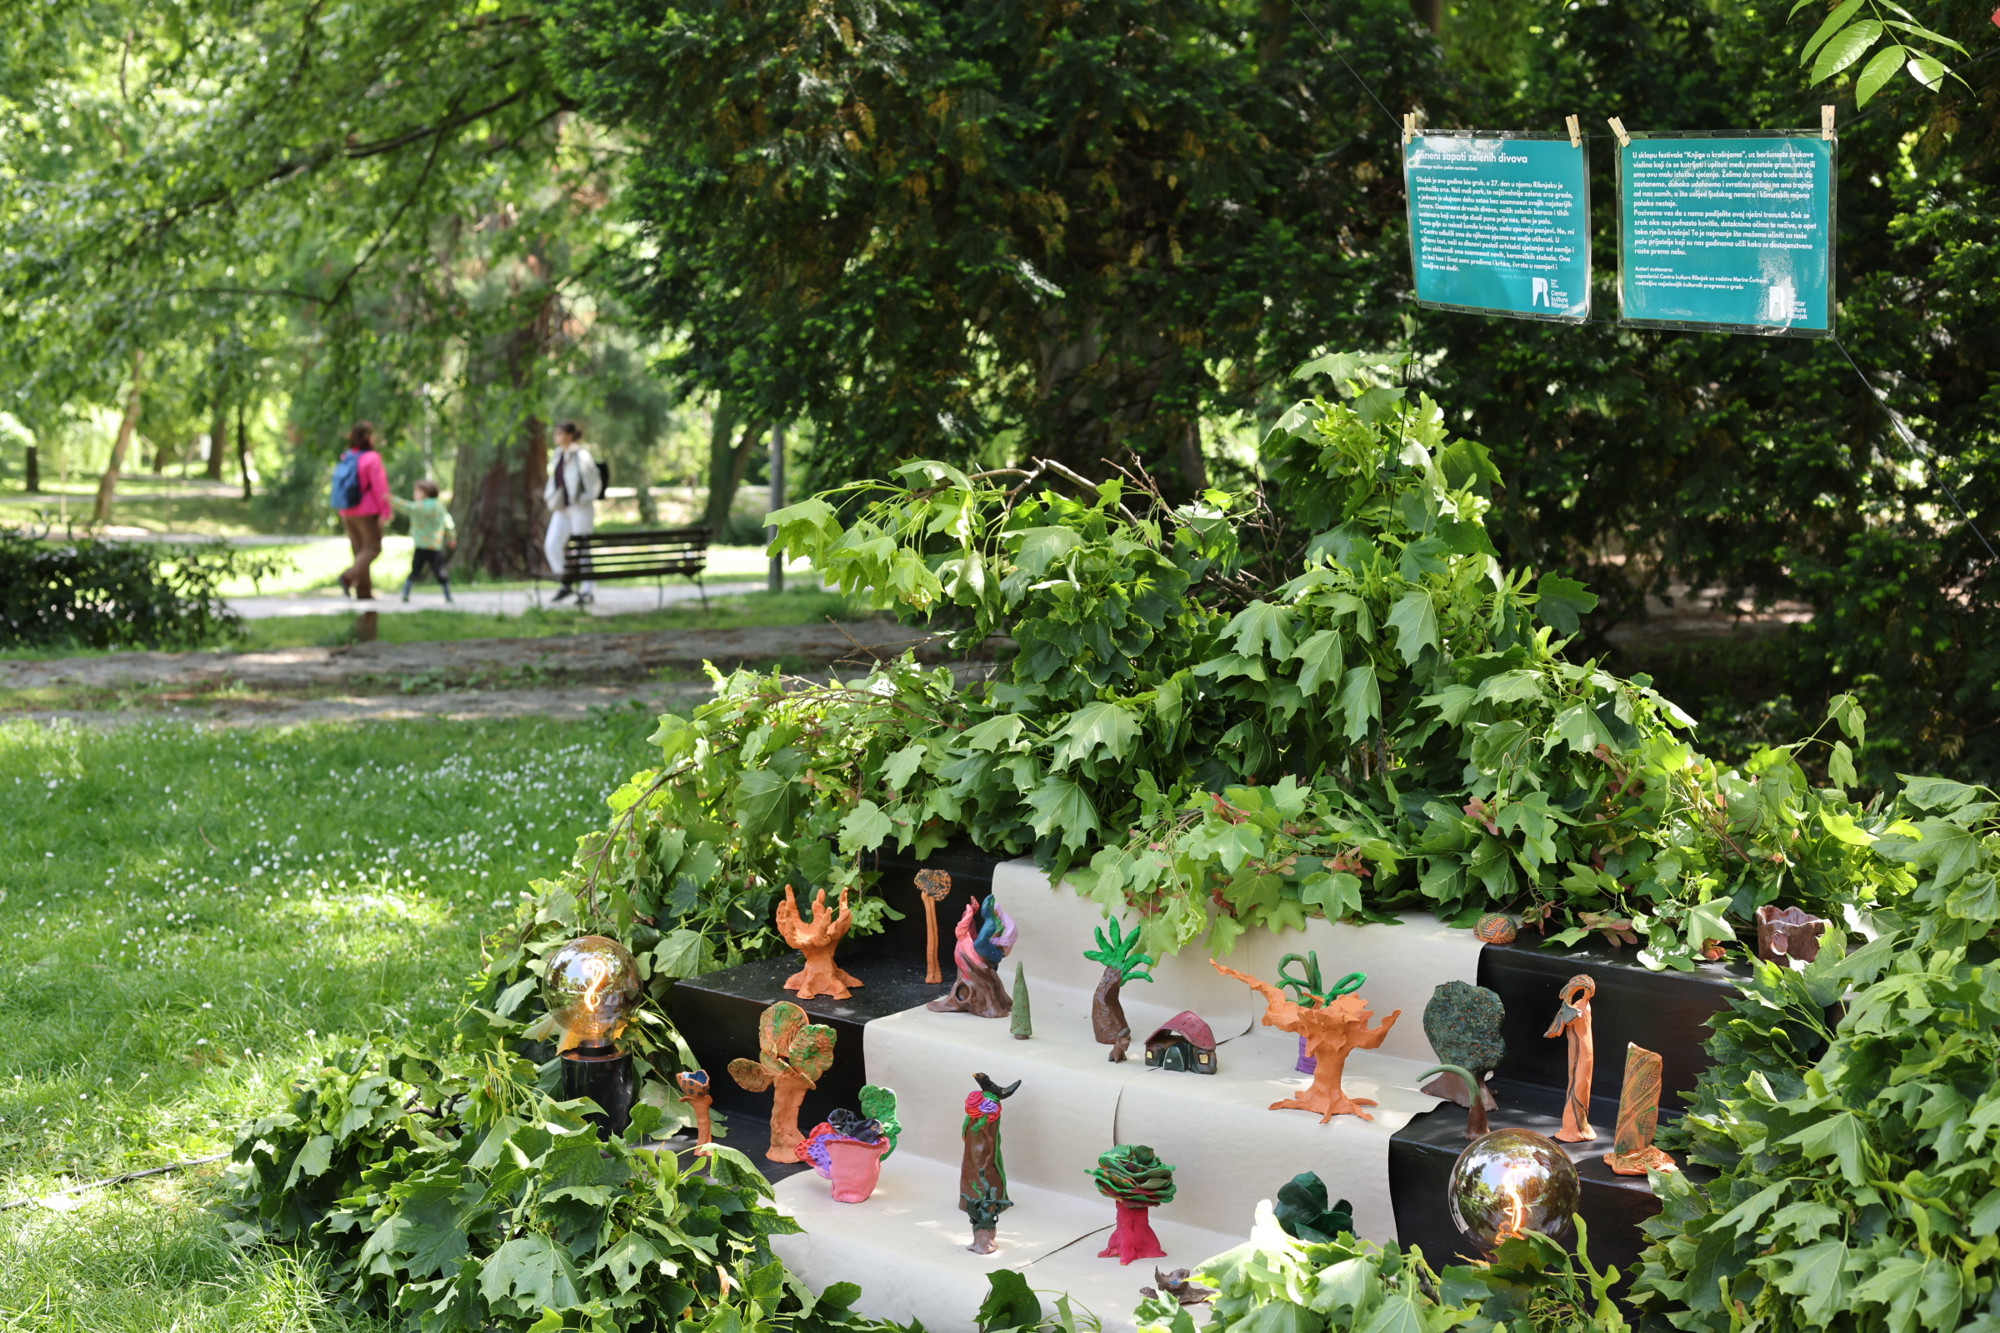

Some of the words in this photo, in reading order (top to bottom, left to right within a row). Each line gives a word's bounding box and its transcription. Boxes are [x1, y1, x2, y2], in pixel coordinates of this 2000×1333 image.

[1416, 150, 1440, 161] Glineni
[1443, 151, 1466, 164] šapati
[1468, 151, 1496, 162] zelenih
[1498, 152, 1528, 164] divova
